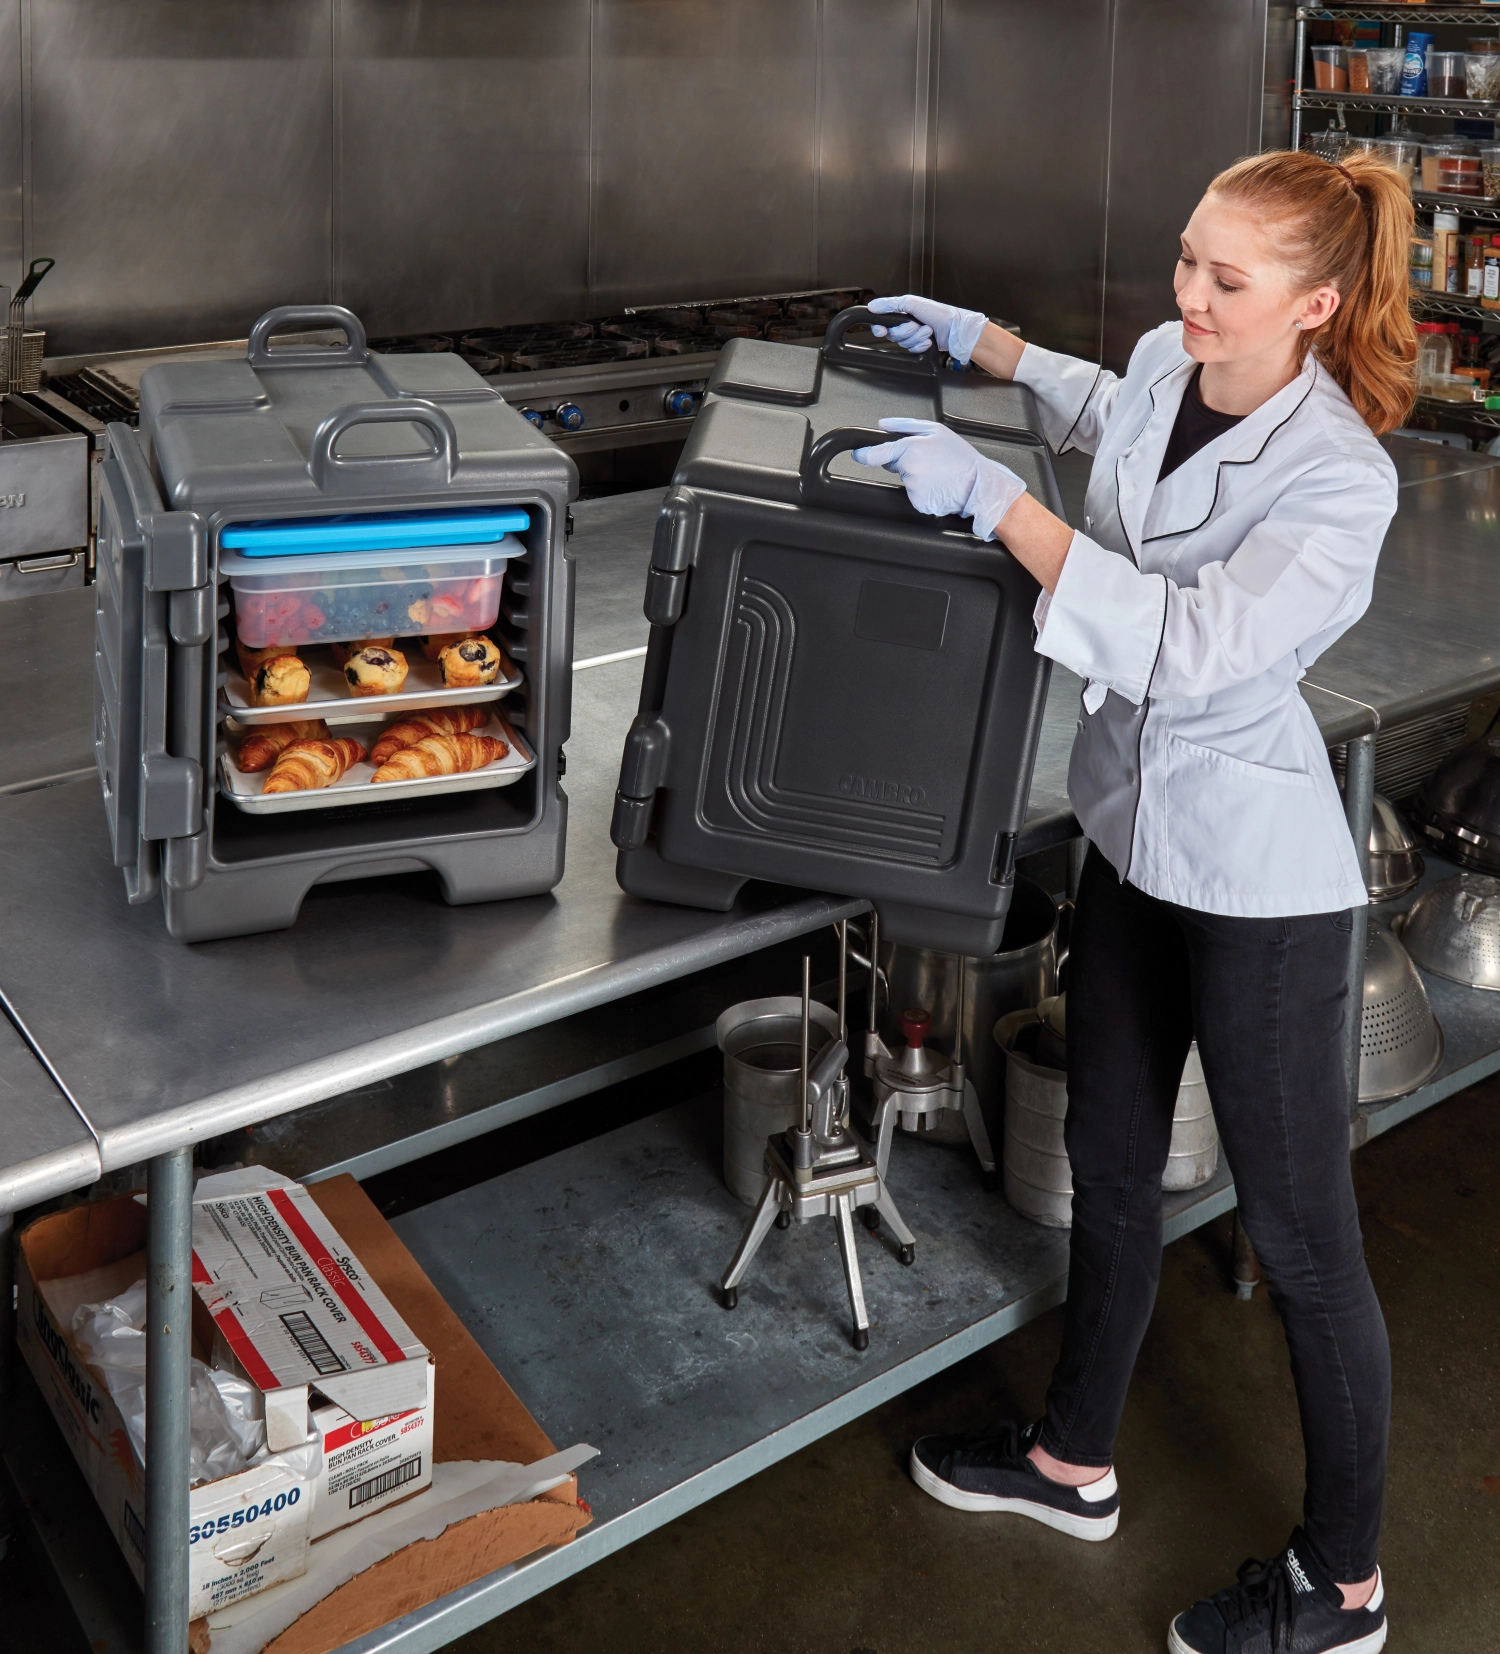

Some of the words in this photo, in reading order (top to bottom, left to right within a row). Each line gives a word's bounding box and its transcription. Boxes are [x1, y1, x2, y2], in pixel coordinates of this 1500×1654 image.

[252, 1196, 271, 1215] HIGH
[265, 1215, 292, 1245] DENSITY
[285, 1245, 303, 1261] BUN
[299, 1261, 314, 1277] PAN
[308, 1277, 327, 1298] RACK
[323, 1297, 347, 1323] COVER
[317, 1257, 346, 1288] Classic
[351, 1341, 376, 1364] 5854377
[400, 1418, 424, 1435] 5854377
[328, 1451, 344, 1463] HIGH
[346, 1438, 372, 1455] DENSITY
[328, 1457, 341, 1468] BUN
[343, 1451, 356, 1461] PAN
[359, 1443, 373, 1454] RACK
[375, 1433, 395, 1447] COVER
[202, 1583, 210, 1591] 18
[212, 1575, 232, 1586] inches
[240, 1563, 259, 1576] 2,000
[261, 1556, 275, 1567] Feet
[1287, 1548, 1313, 1592] adidas
[211, 1591, 223, 1600] 457
[225, 1587, 237, 1595] mm
[244, 1578, 256, 1587] 610
